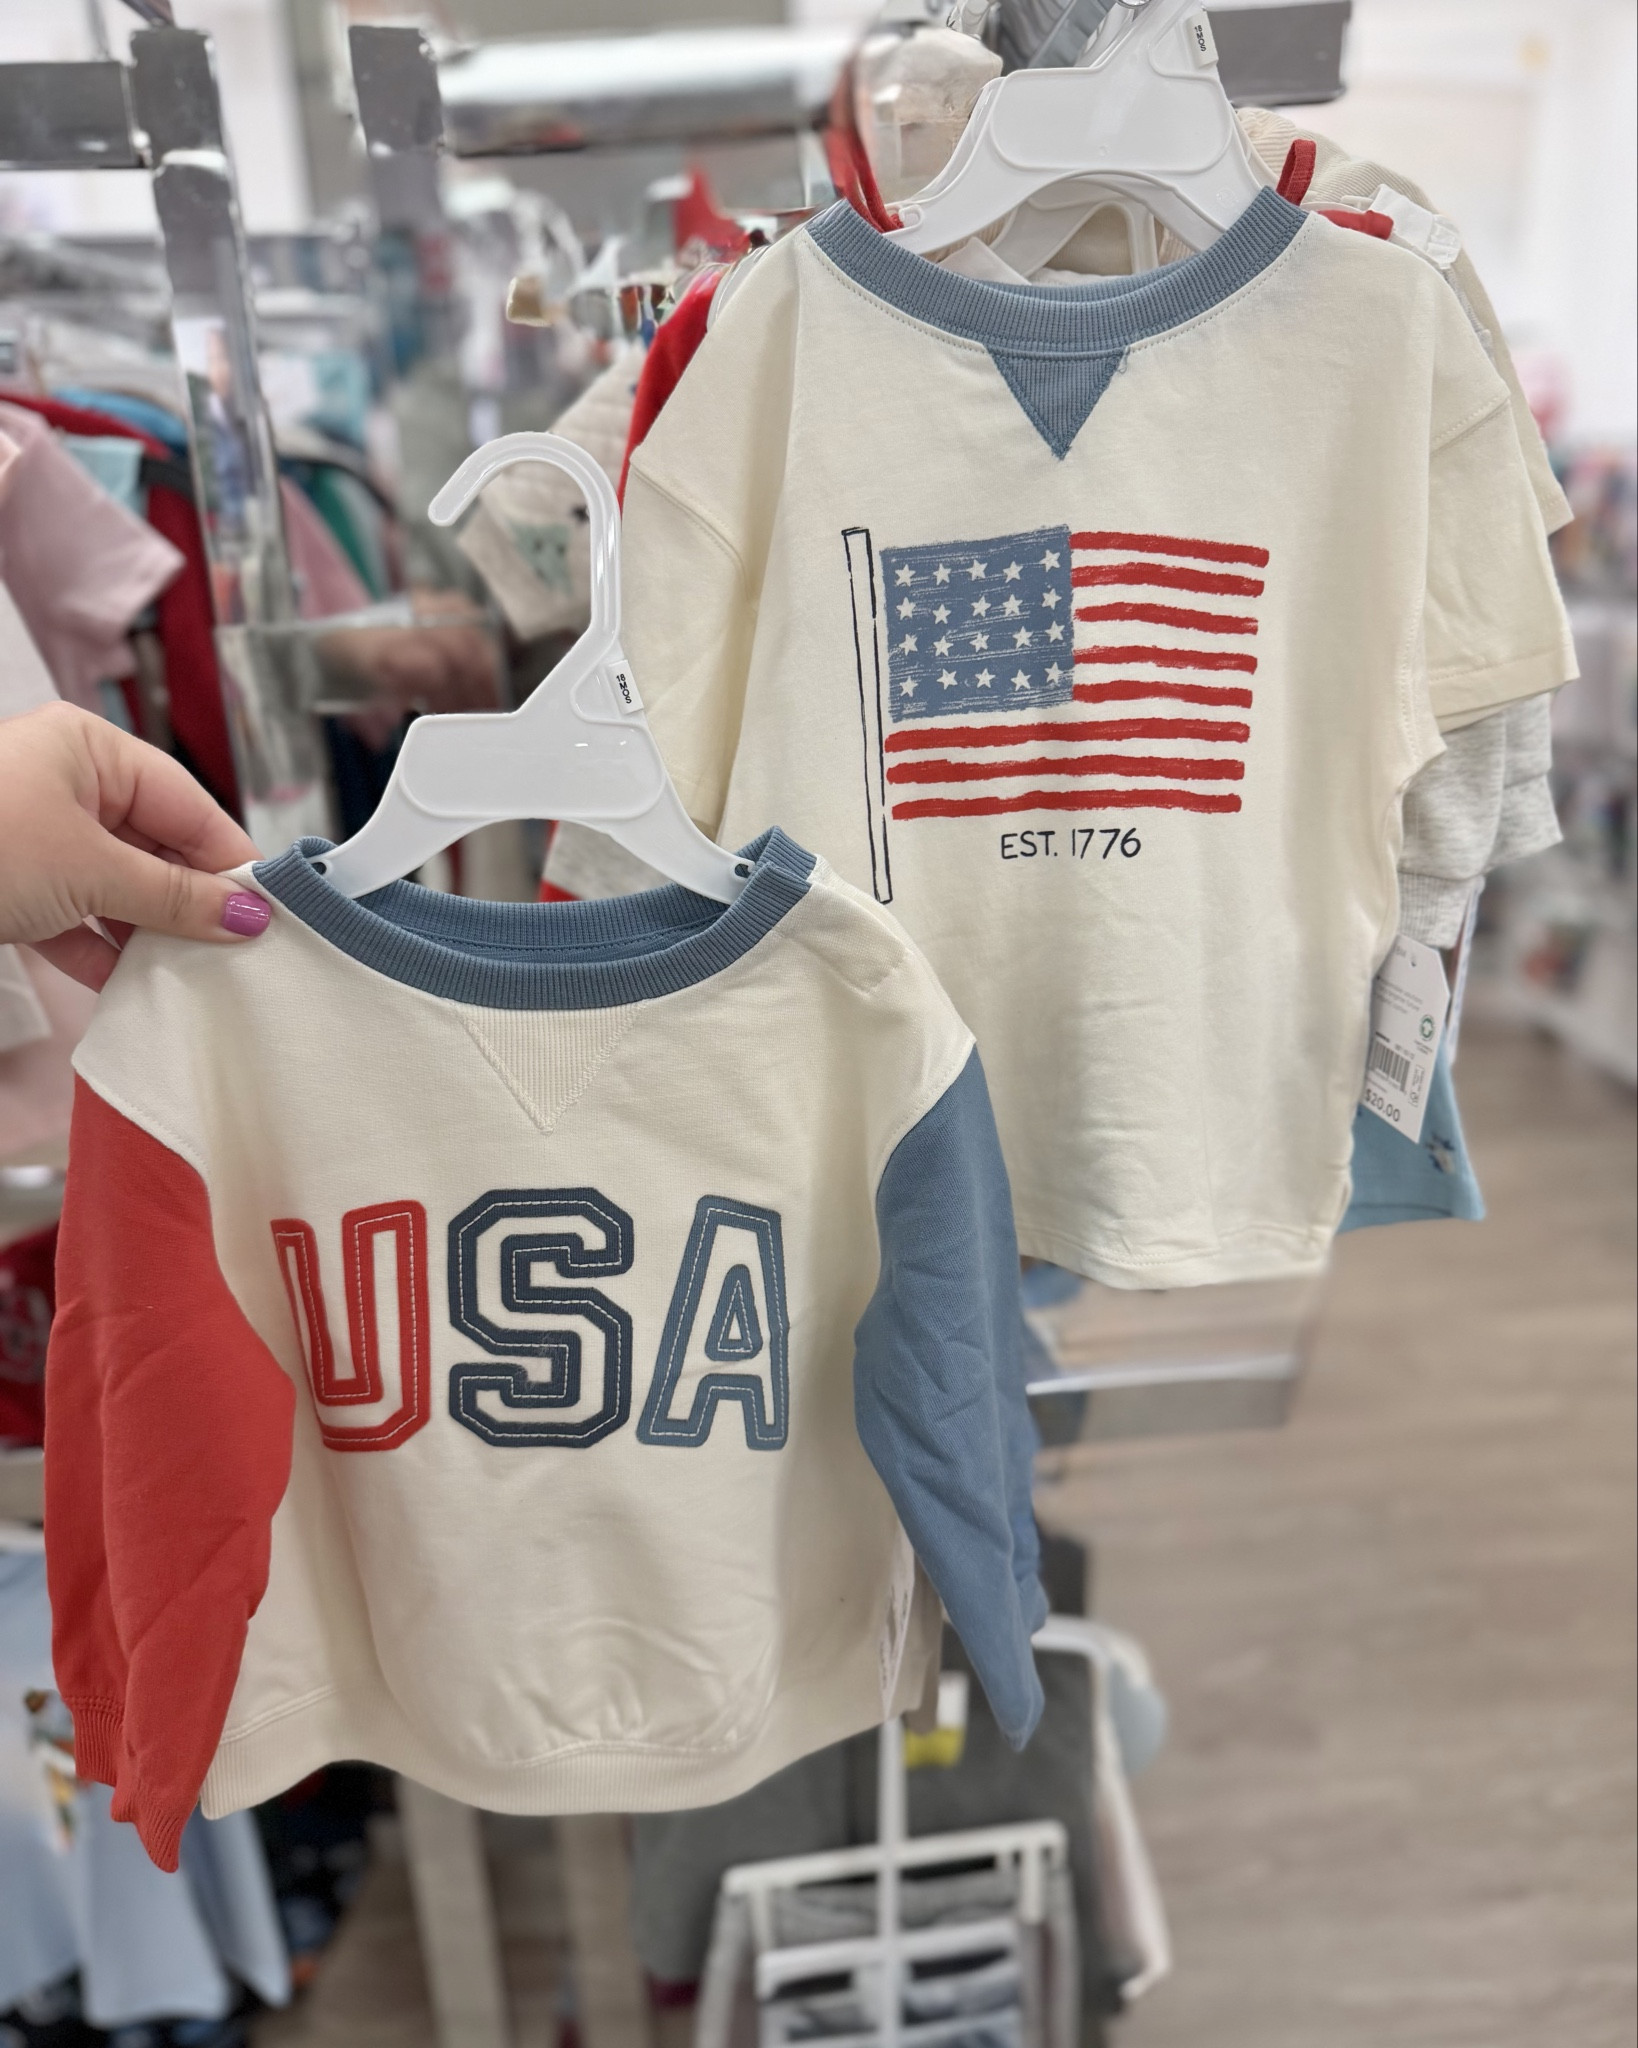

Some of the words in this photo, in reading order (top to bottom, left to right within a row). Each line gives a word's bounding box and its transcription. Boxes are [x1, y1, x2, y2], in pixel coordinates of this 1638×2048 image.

[1001, 830, 1058, 860] EST.
[1072, 827, 1141, 860] 1776
[1364, 1088, 1401, 1122] $20.00
[270, 1187, 790, 1451] USA
